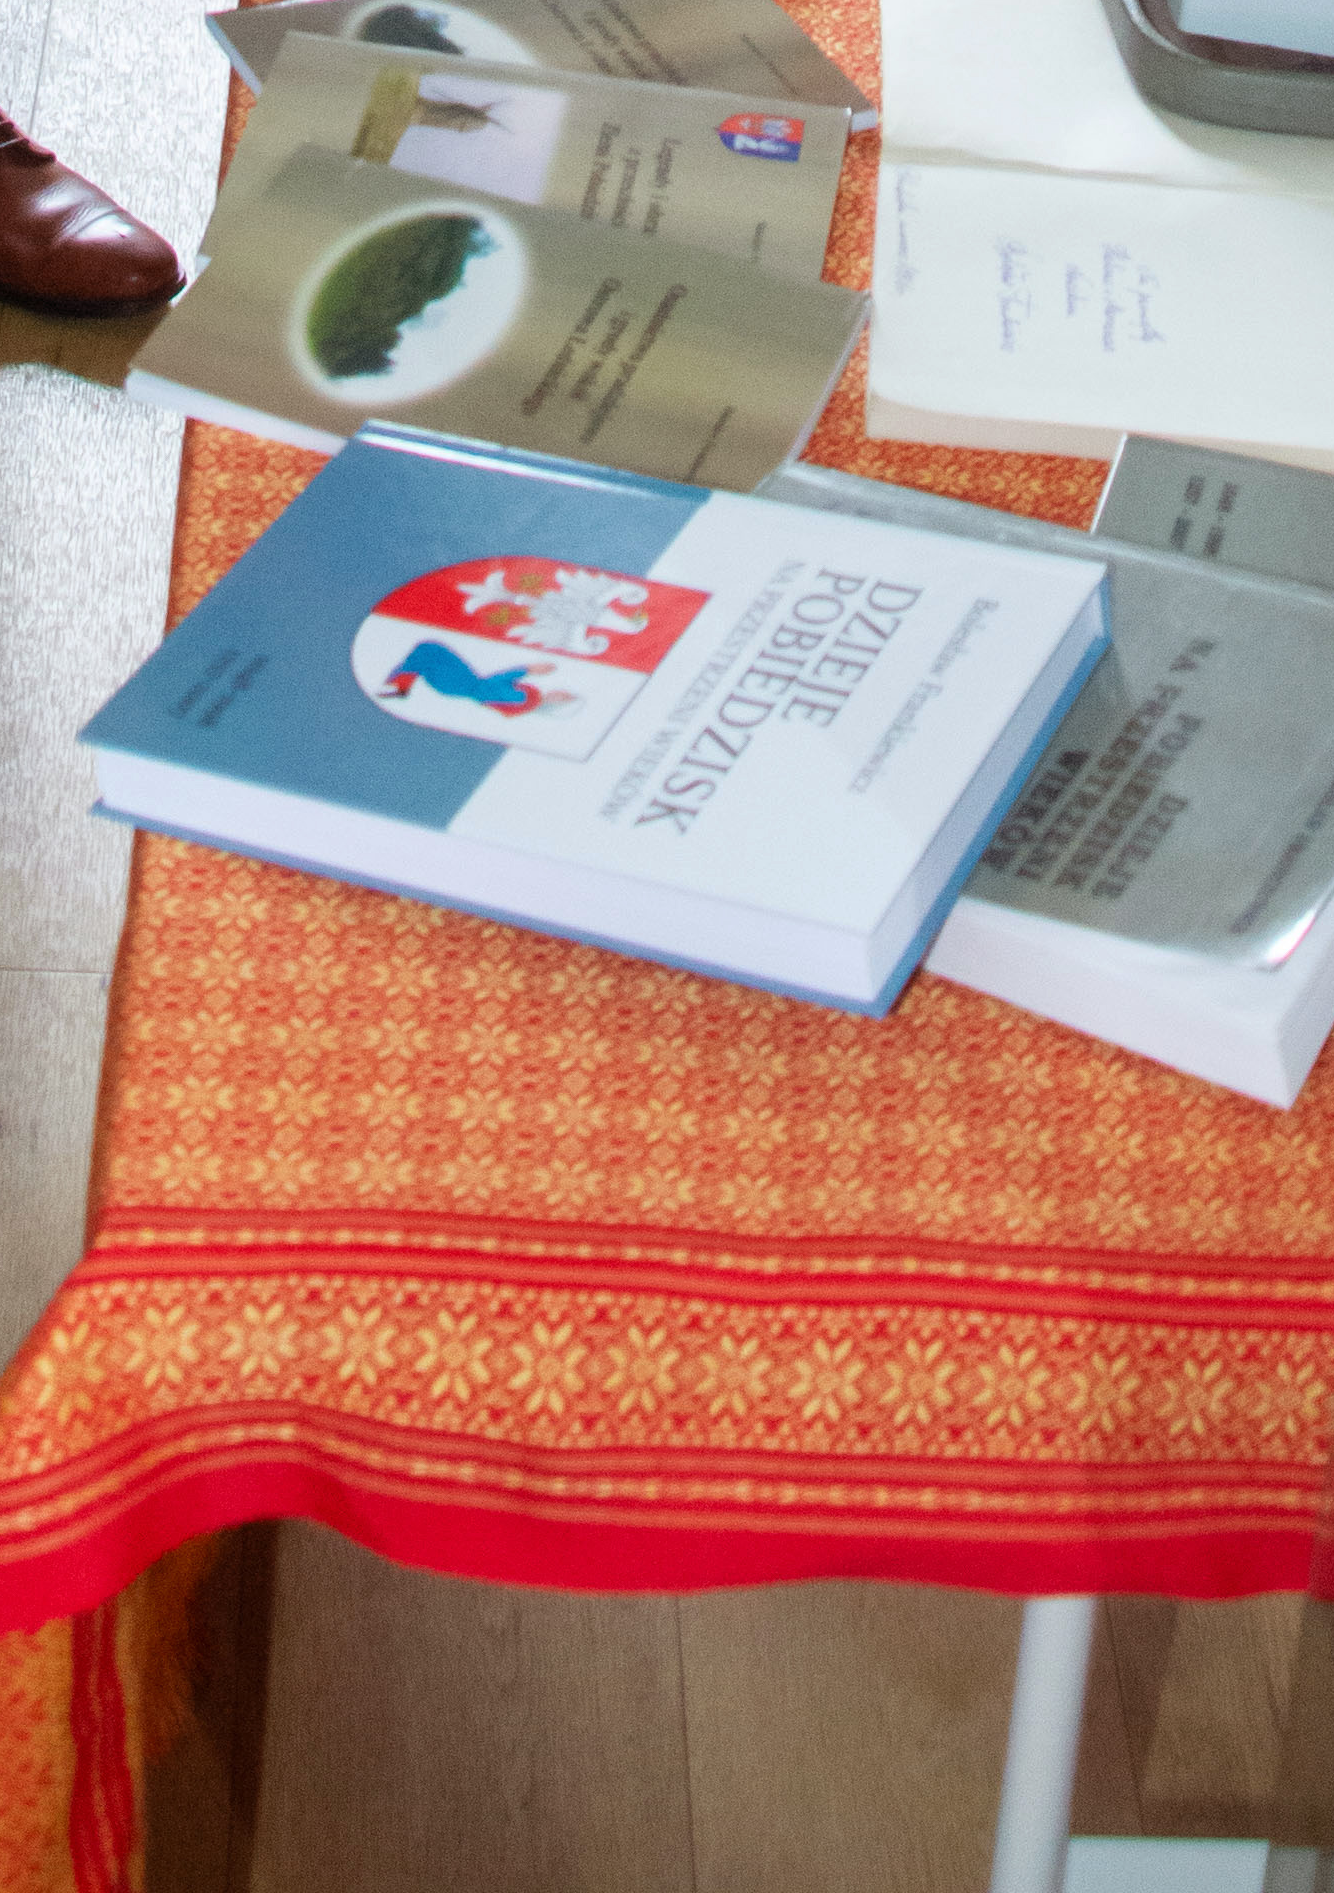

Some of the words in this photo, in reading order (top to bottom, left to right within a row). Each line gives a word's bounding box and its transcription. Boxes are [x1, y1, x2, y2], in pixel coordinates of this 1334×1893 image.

[763, 558, 808, 590] NA
[629, 566, 869, 838] POBIEDZISK
[660, 587, 787, 728] PRZESTRZENI
[768, 575, 927, 730] DZIEJE
[588, 726, 688, 826] WIEKÓW
